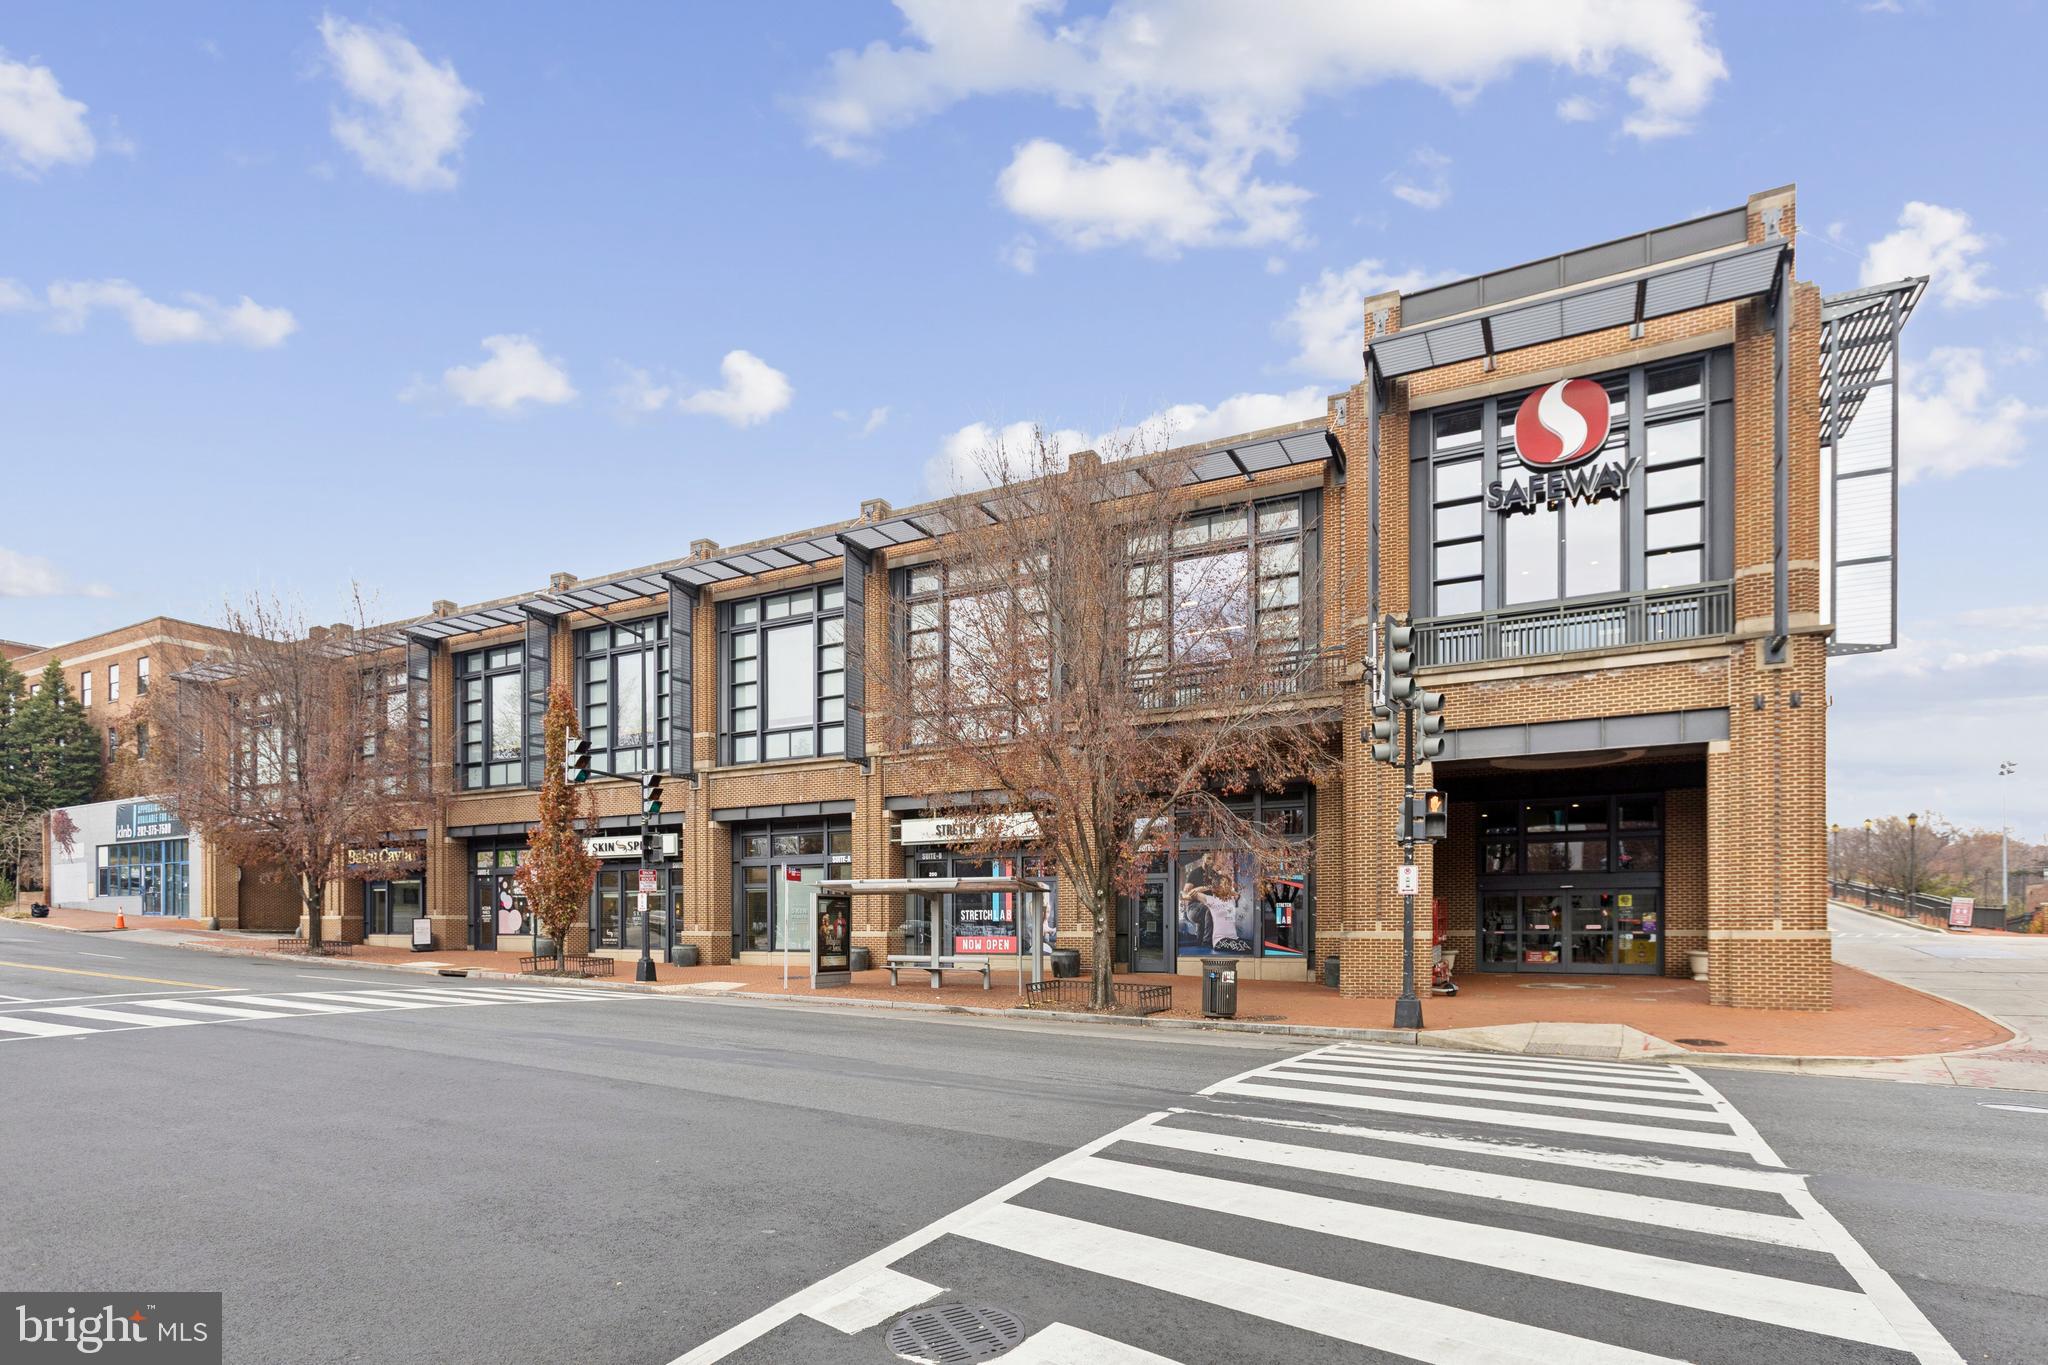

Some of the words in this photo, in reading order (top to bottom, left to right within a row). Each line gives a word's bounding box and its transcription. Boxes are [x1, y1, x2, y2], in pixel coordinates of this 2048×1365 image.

[1487, 456, 1641, 512] SAFEWAY
[592, 842, 615, 853] SKIN
[962, 939, 982, 950] NOW
[986, 939, 1010, 950] OPEN
